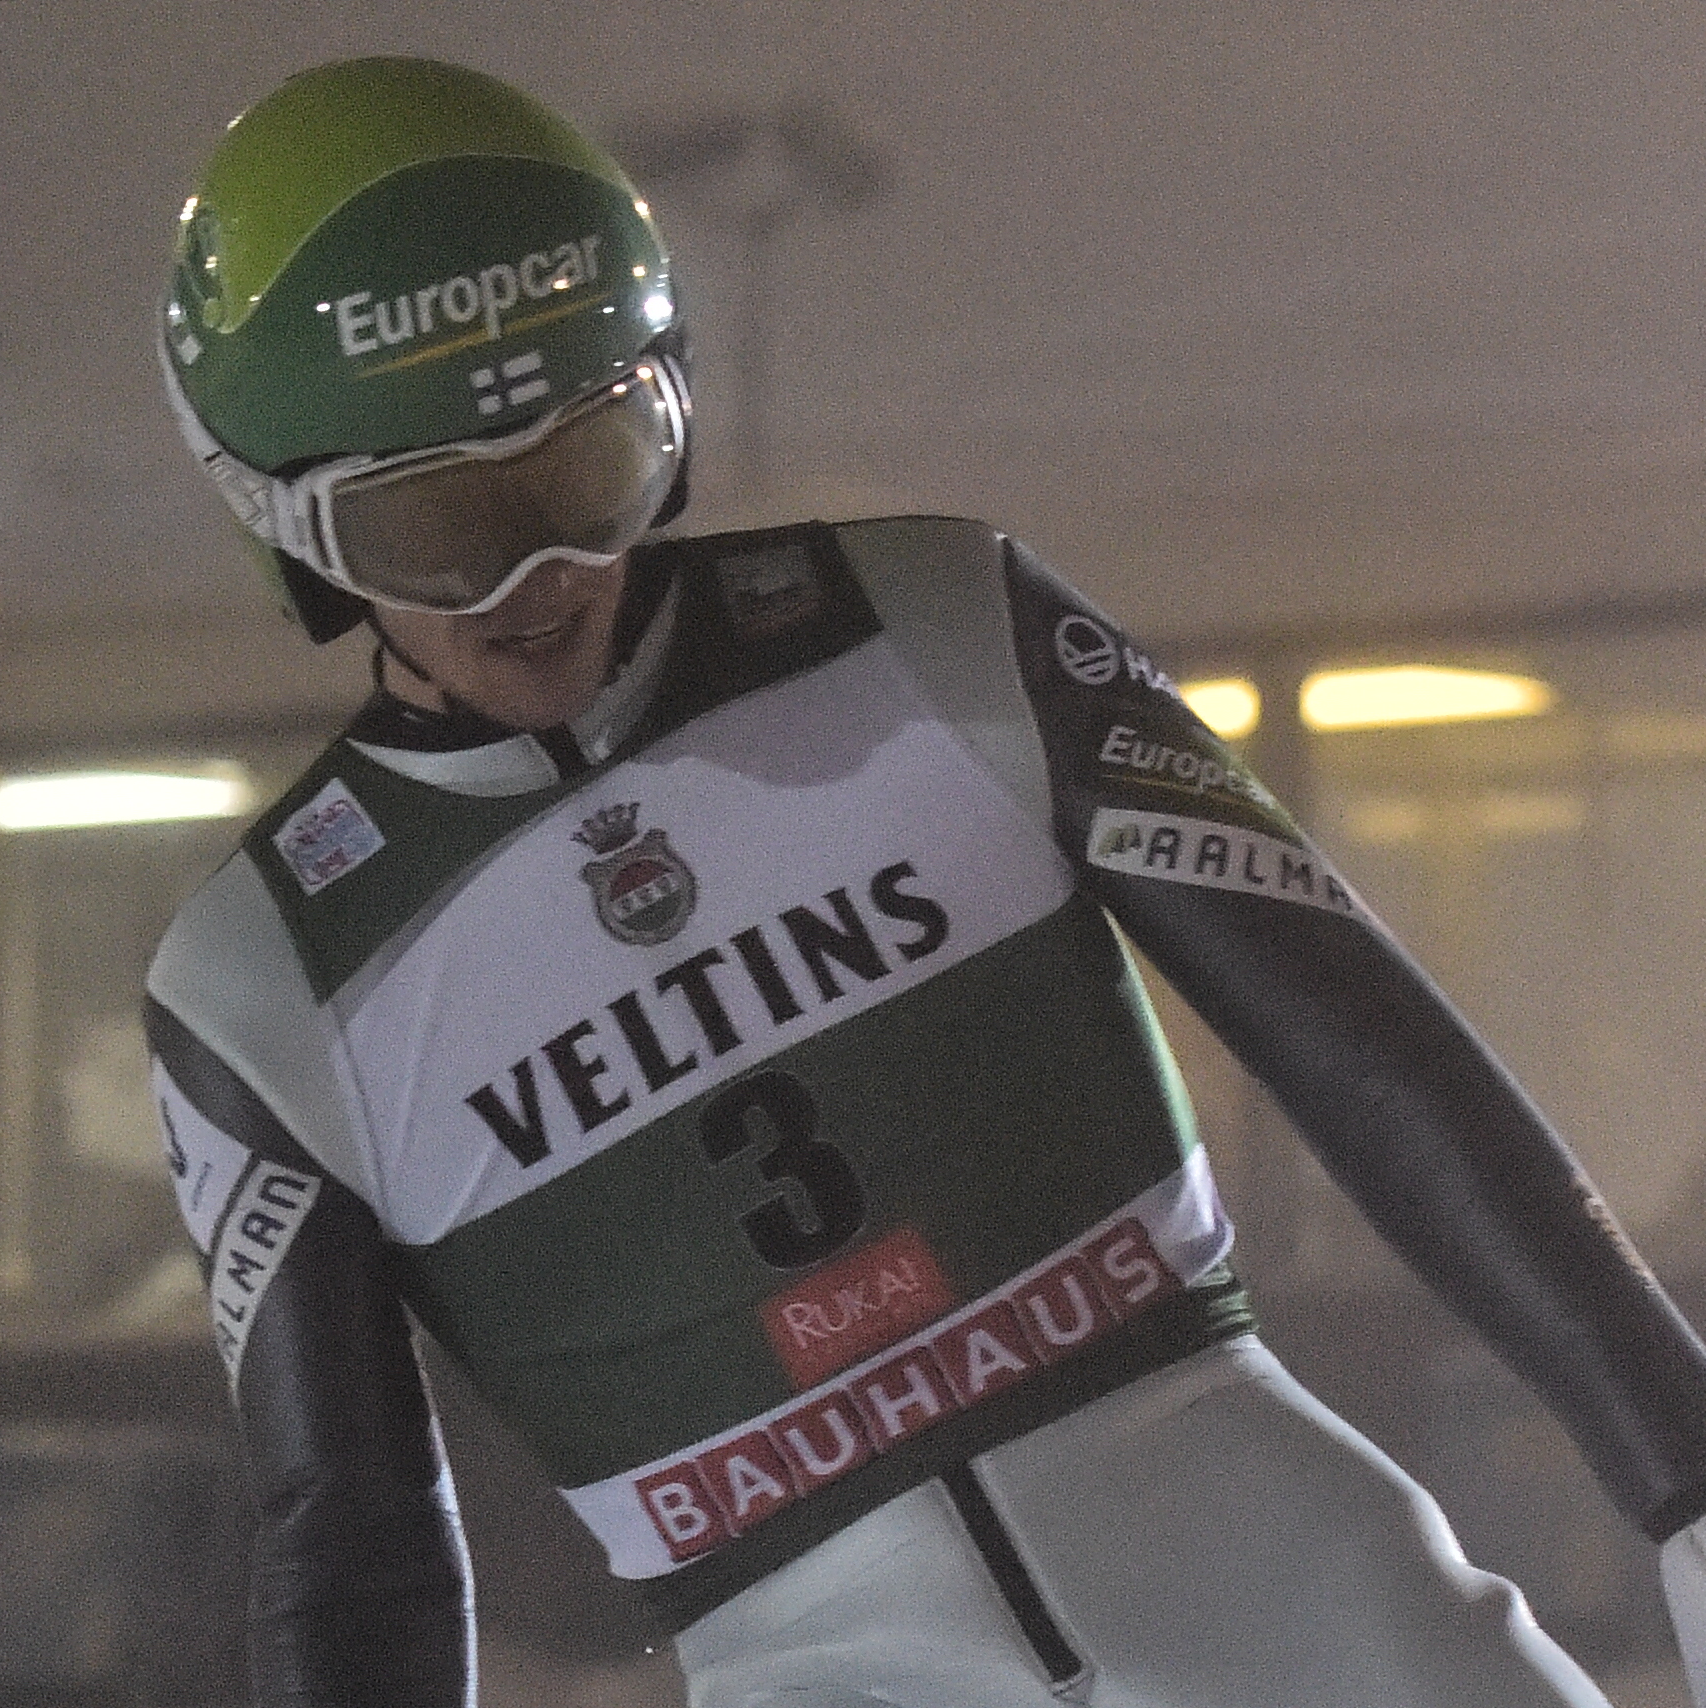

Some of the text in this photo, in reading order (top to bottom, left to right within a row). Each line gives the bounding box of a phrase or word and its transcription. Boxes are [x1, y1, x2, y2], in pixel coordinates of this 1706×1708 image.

[334, 235, 602, 356] Europcar
[465, 861, 952, 1171] VELTINS
[699, 1070, 866, 1270] 3
[647, 1235, 1164, 1545] BAUHAUS
